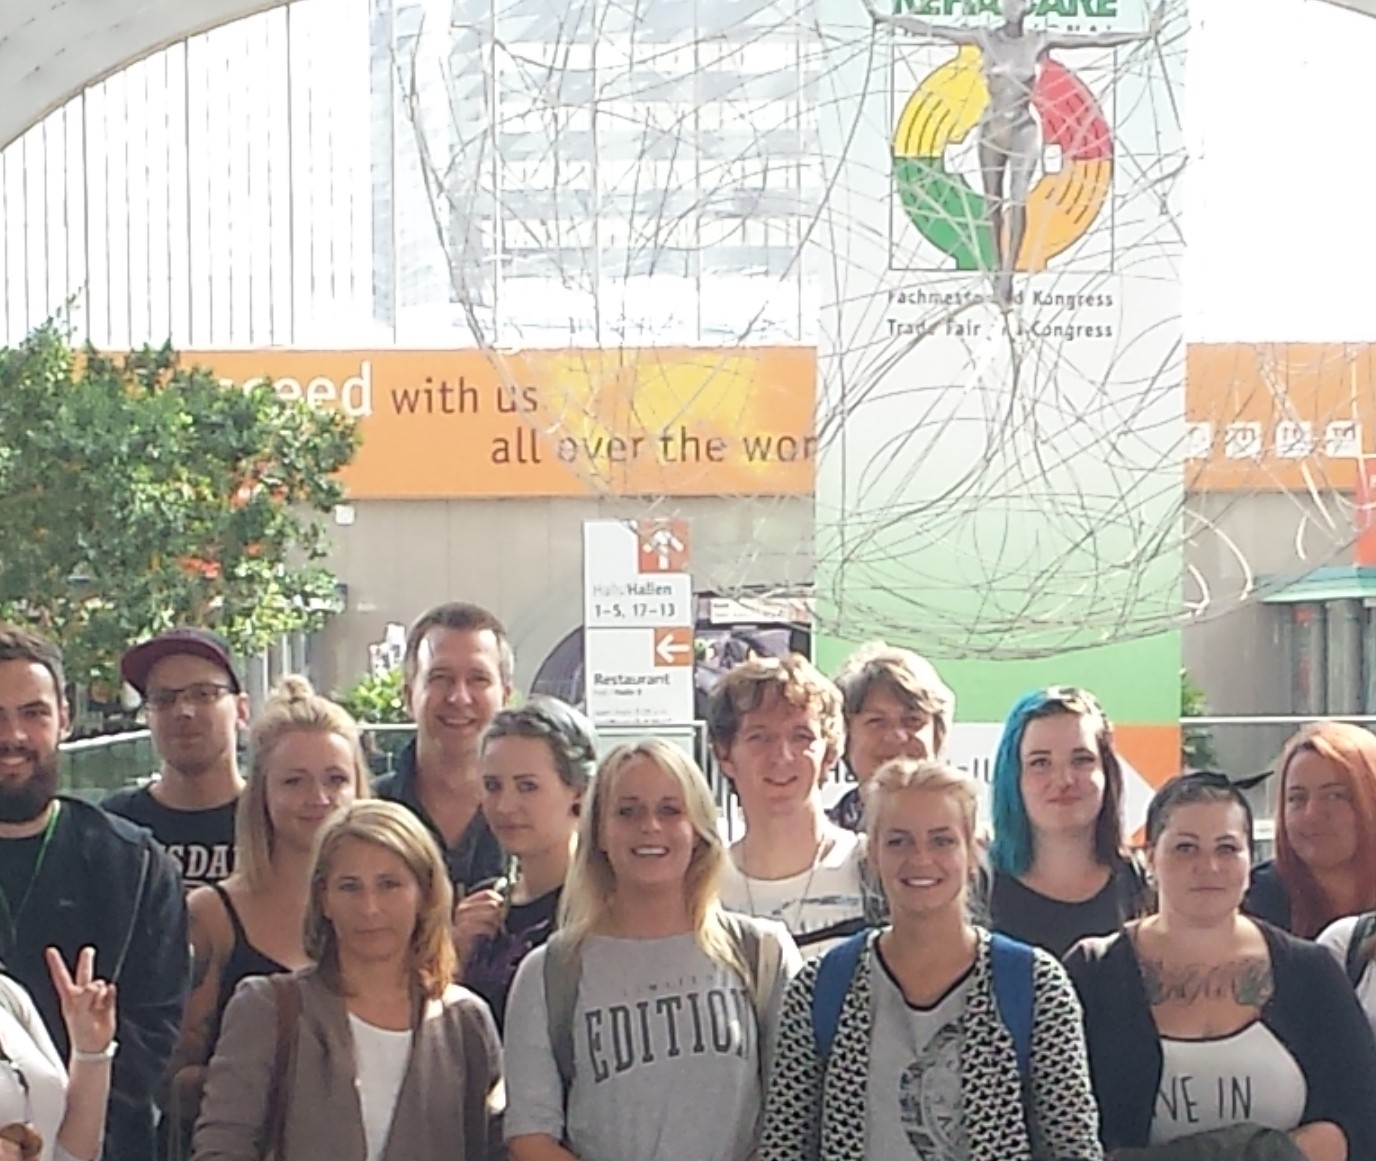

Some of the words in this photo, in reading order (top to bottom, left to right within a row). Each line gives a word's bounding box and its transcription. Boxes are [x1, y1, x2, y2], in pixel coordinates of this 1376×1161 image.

[1032, 291, 1114, 310] Kongress
[1030, 321, 1113, 341] Congress
[391, 376, 479, 414] with
[496, 386, 538, 413] us
[491, 426, 541, 464] all
[557, 437, 647, 463] over
[660, 426, 724, 463] the
[594, 672, 670, 686] Restaurant
[1218, 1075, 1251, 1120] IN
